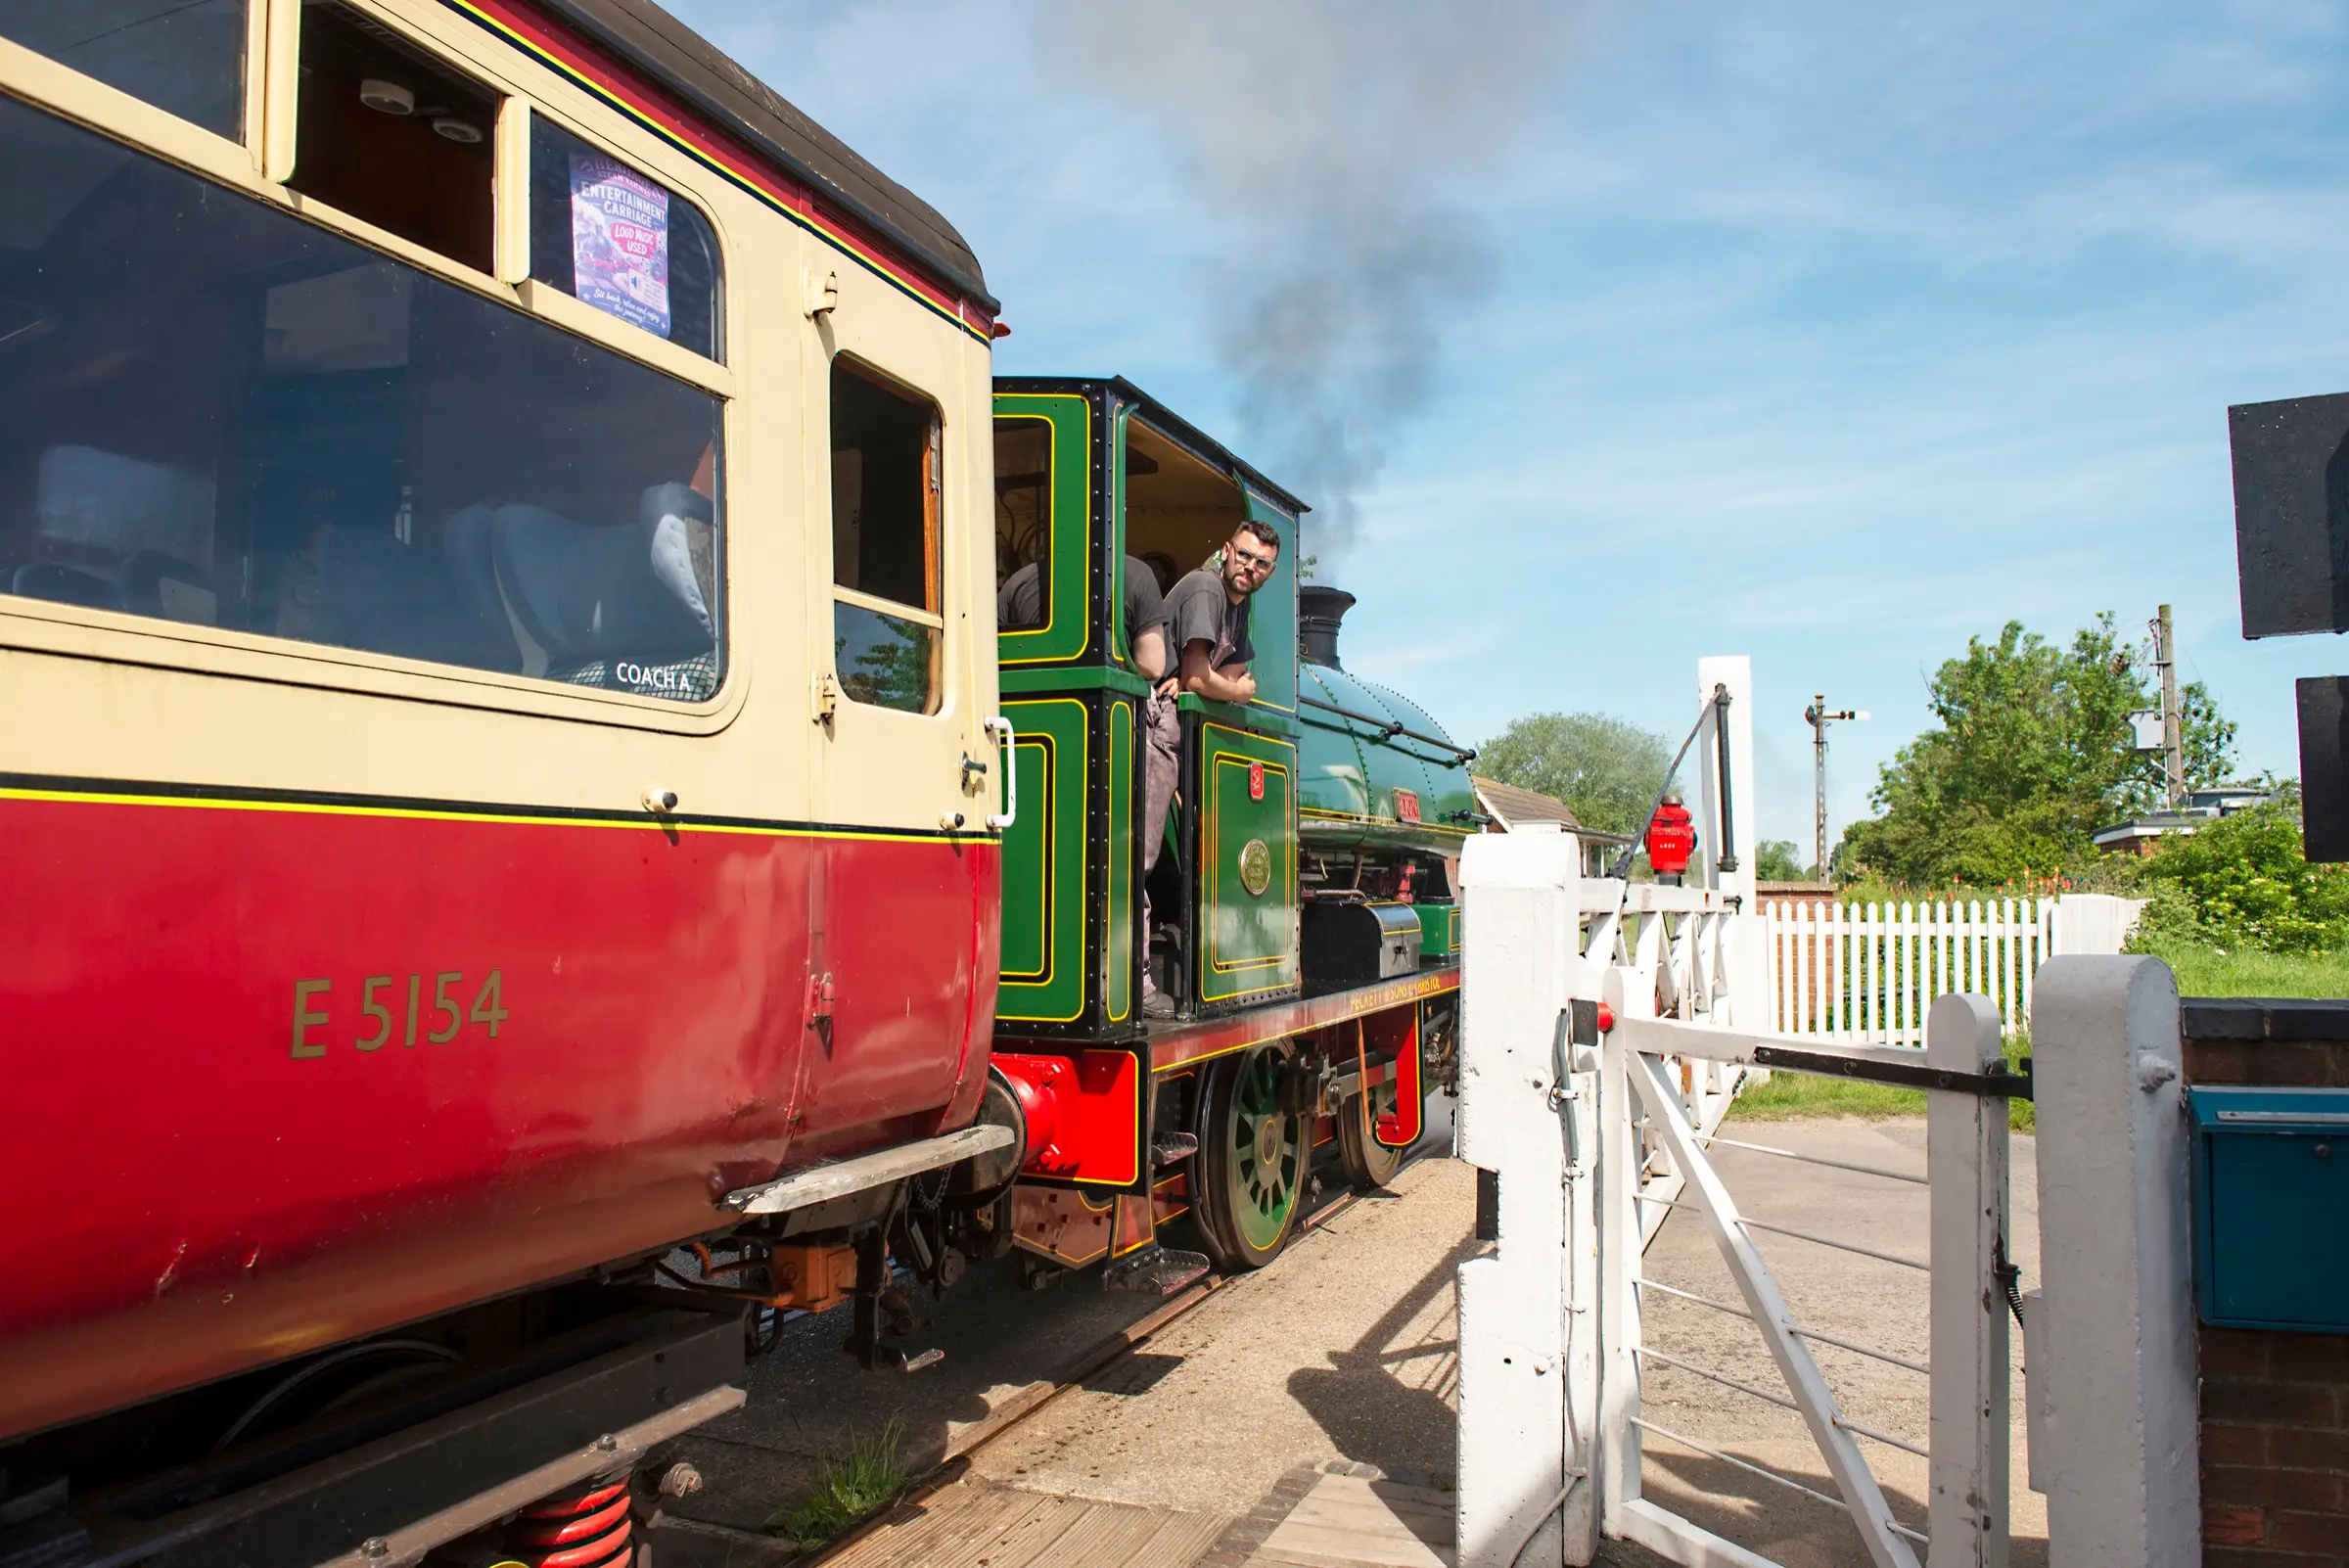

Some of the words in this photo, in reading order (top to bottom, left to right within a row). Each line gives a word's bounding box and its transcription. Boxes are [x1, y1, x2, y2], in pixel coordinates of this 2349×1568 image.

[581, 180, 667, 223] ENTERTAINMENT
[603, 201, 652, 228] CARRIAGE
[614, 224, 634, 240] LOUD
[626, 241, 647, 255] USED
[617, 663, 675, 689] COACH
[679, 673, 691, 692] A
[1350, 989, 1382, 1011] PECKETT
[1390, 982, 1407, 1000] SONS
[1417, 975, 1441, 993] BRISTOL
[290, 978, 331, 1060] E
[354, 968, 509, 1053] 5154
